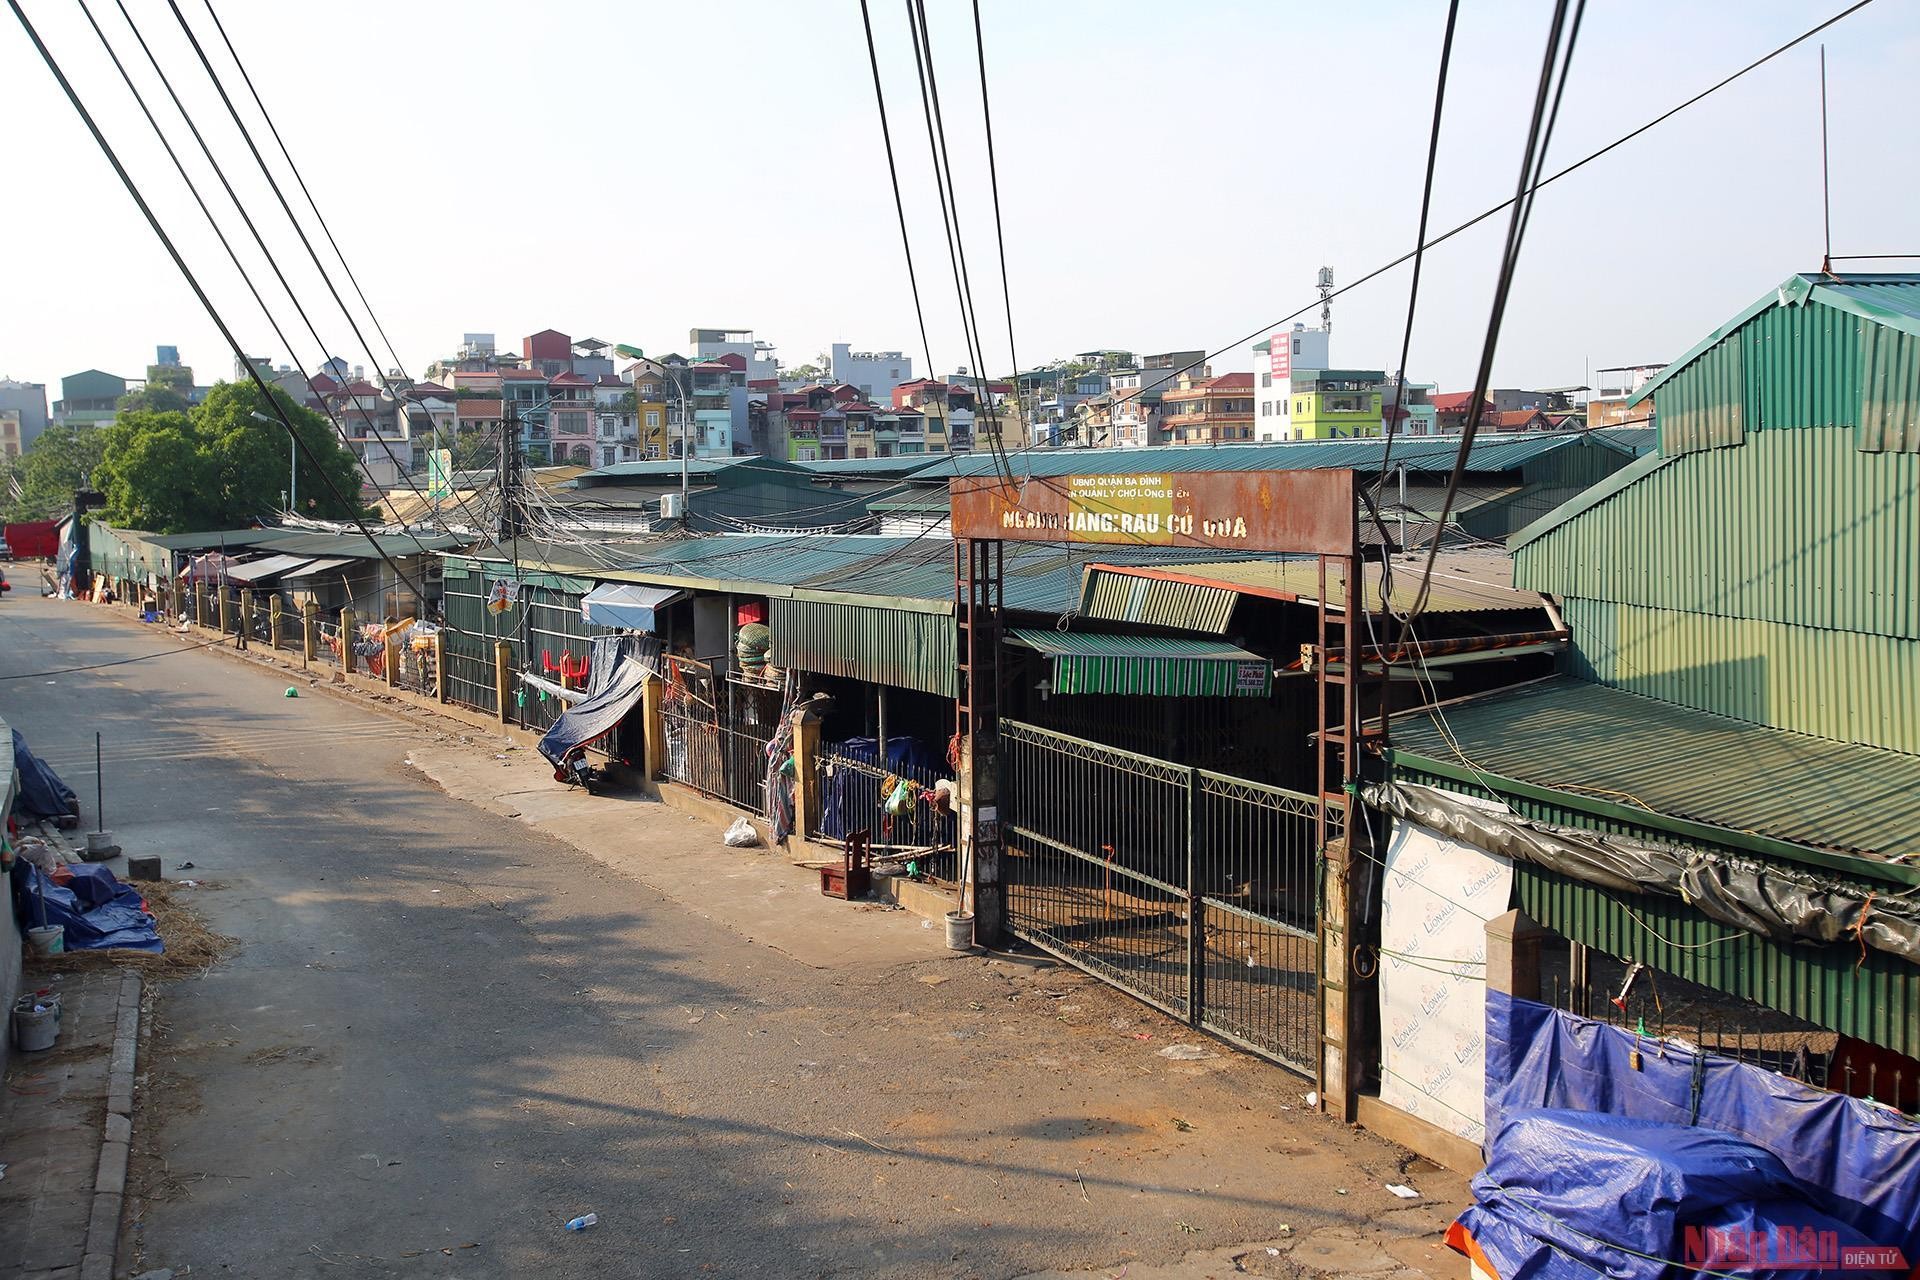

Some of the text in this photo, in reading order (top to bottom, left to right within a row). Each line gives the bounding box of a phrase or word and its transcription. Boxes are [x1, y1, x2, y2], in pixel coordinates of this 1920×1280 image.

[1072, 478, 1096, 487] UBND
[1125, 477, 1138, 486] BA
[1137, 488, 1165, 499] LONG
[1120, 513, 1160, 534] RAU
